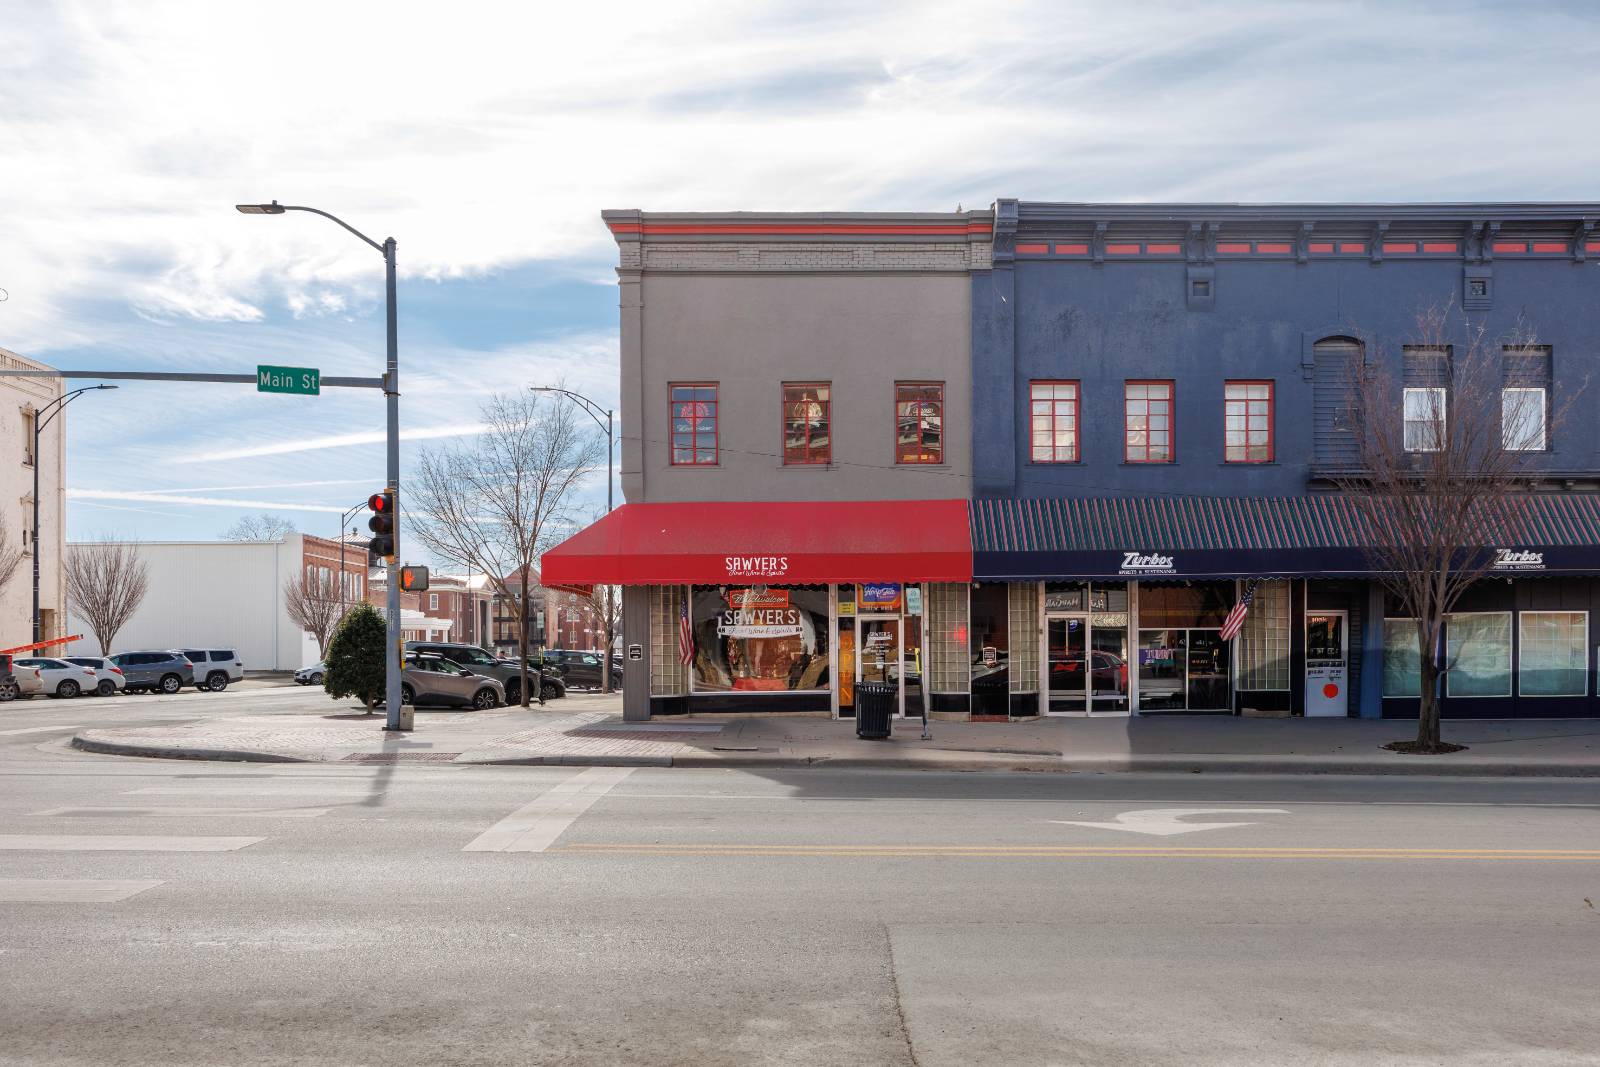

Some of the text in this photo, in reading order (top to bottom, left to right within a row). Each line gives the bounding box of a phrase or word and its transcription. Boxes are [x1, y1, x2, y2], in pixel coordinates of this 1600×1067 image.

[260, 371, 317, 389] Main St
[725, 557, 788, 570] SAWYER'S
[1121, 552, 1174, 569] Turbos
[725, 609, 796, 625] SAWYER'S
